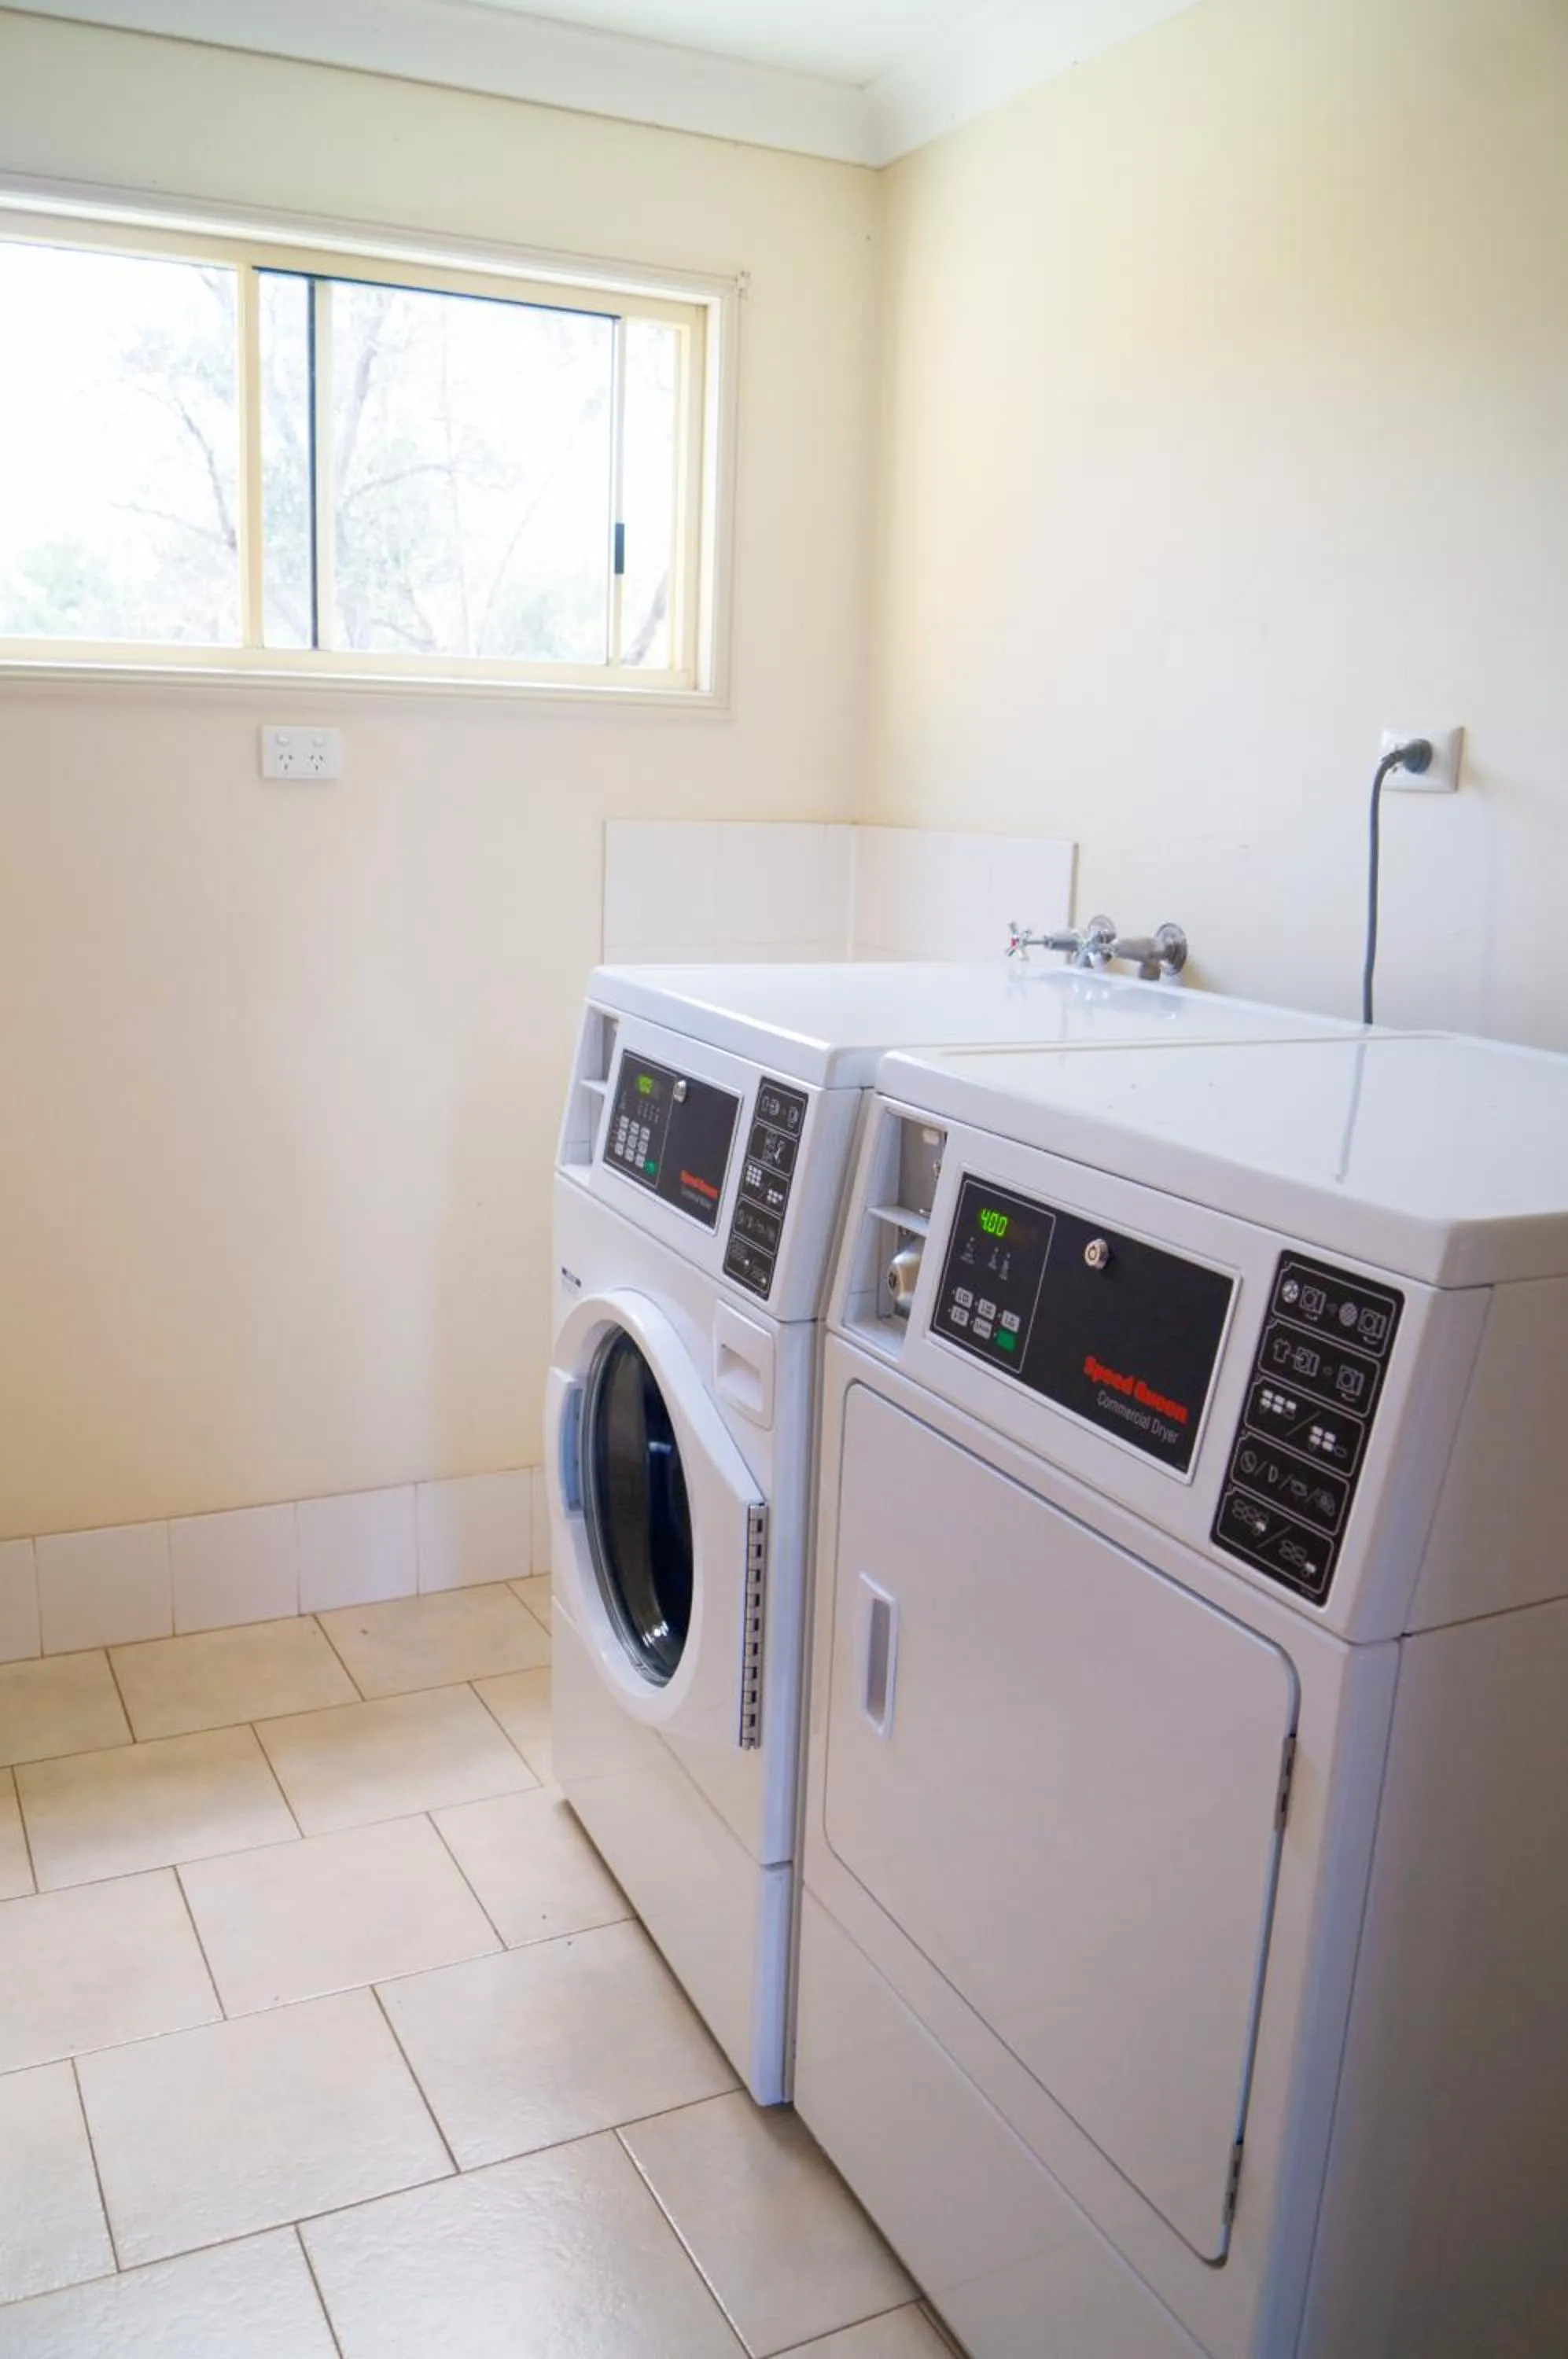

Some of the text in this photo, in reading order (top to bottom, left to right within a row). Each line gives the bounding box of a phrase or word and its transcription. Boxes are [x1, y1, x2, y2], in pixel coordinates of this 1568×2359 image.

[1084, 1355, 1188, 1423] Speed Queen
[1097, 1389, 1180, 1444] Commercial Dryer
